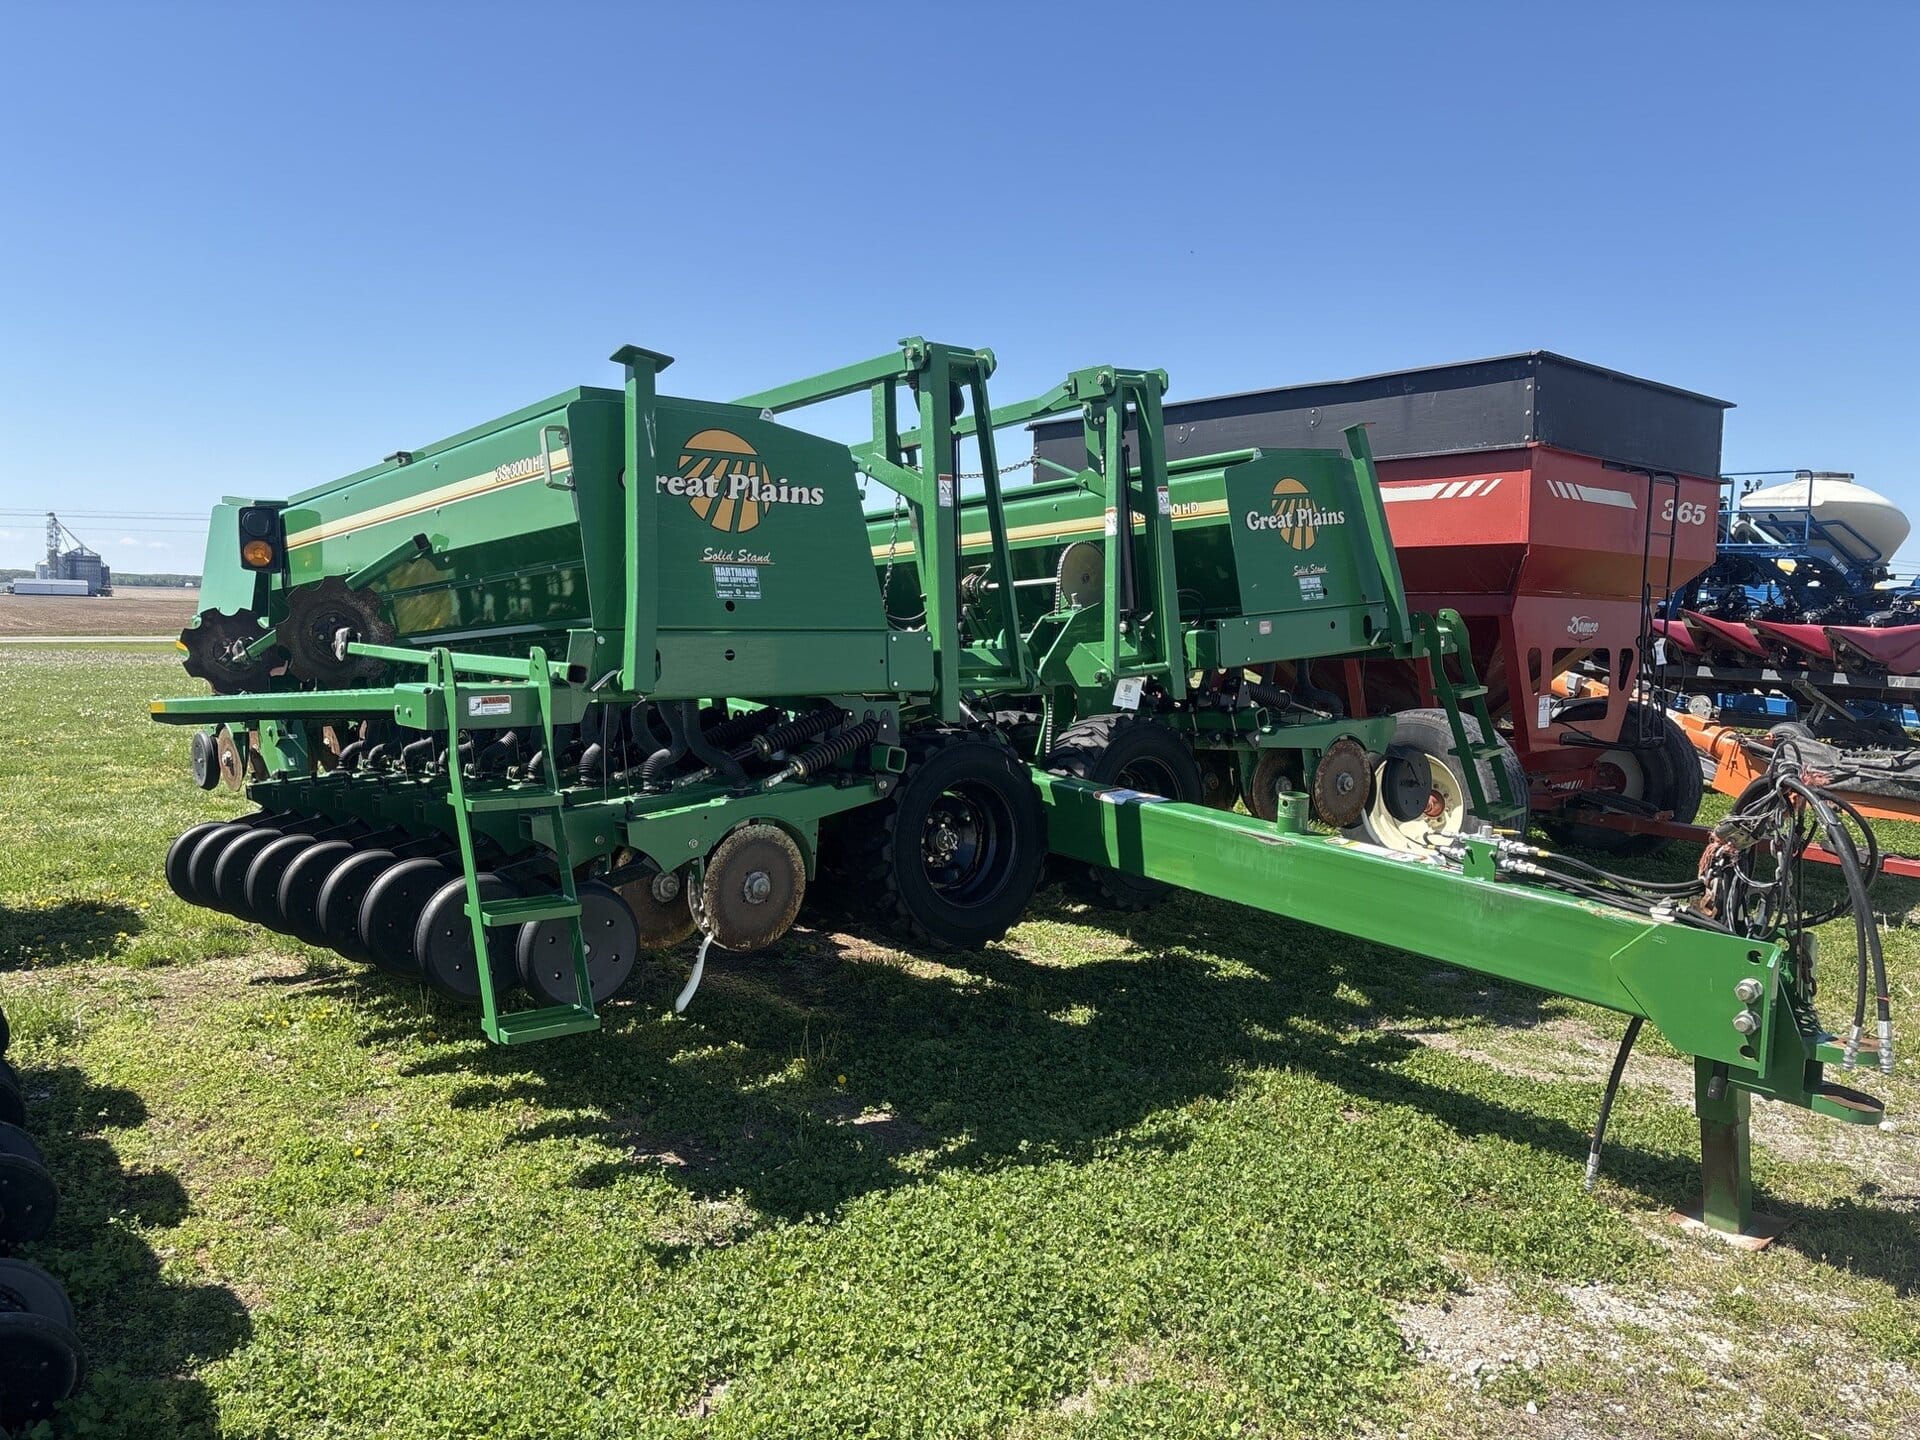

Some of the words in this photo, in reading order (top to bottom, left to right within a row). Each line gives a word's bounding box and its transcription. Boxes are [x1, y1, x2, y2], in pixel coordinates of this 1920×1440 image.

[620, 471, 719, 498] reat
[727, 473, 824, 506] Plains
[1246, 510, 1293, 531] Great
[1296, 506, 1345, 527] Plains
[1661, 498, 1708, 525] 365
[703, 547, 734, 561] Solid
[738, 549, 771, 562] Stand
[714, 566, 758, 577] HARTMANN
